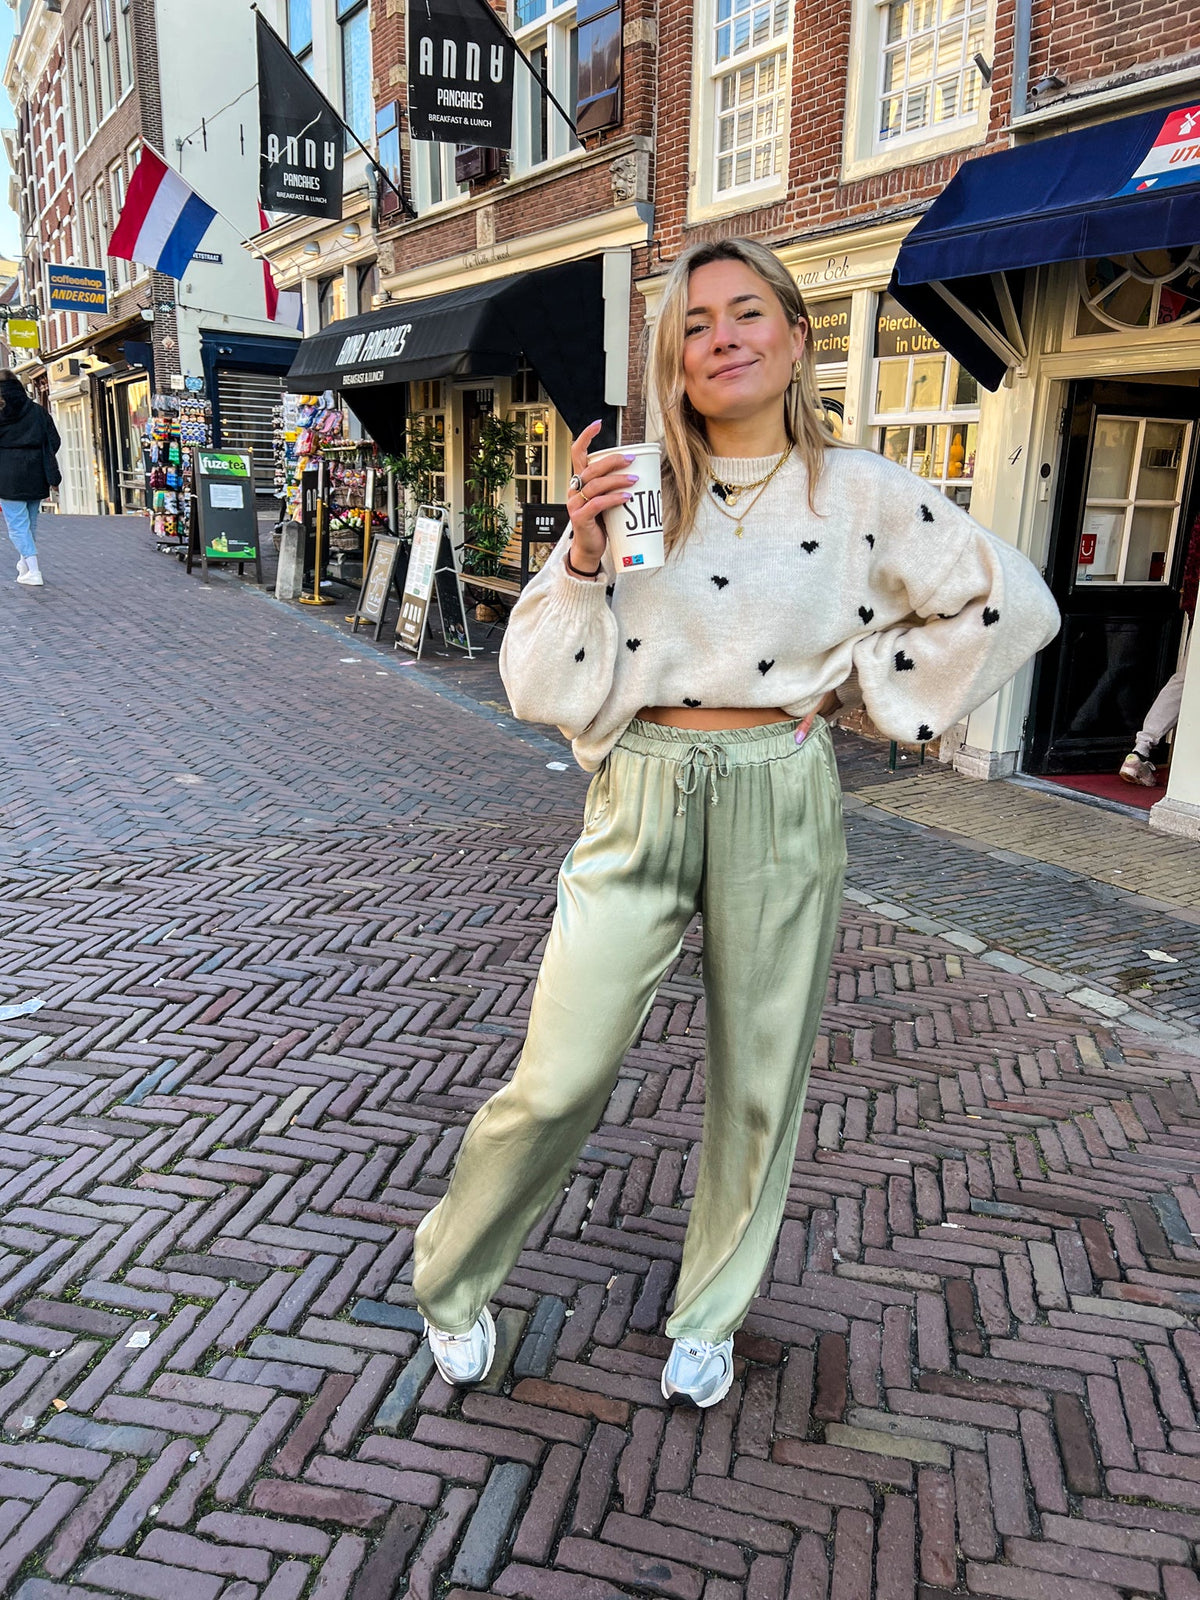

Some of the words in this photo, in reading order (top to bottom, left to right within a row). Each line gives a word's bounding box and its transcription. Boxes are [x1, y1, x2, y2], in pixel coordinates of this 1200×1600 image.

[428, 113, 463, 125] BREAKFAST
[463, 117, 469, 125] &
[470, 118, 492, 128] LUNCH
[276, 191, 305, 201] BREAKFAST
[310, 196, 327, 204] LUNCH
[51, 275, 103, 289] coffeeshop
[51, 288, 105, 304] ANDERSOM
[335, 333, 366, 366] ANNA
[358, 323, 412, 363] PANCAKES
[896, 336, 908, 353] in
[342, 373, 365, 385] BREAKFAST
[368, 370, 385, 382] LUNCH
[1008, 445, 1023, 465] 4
